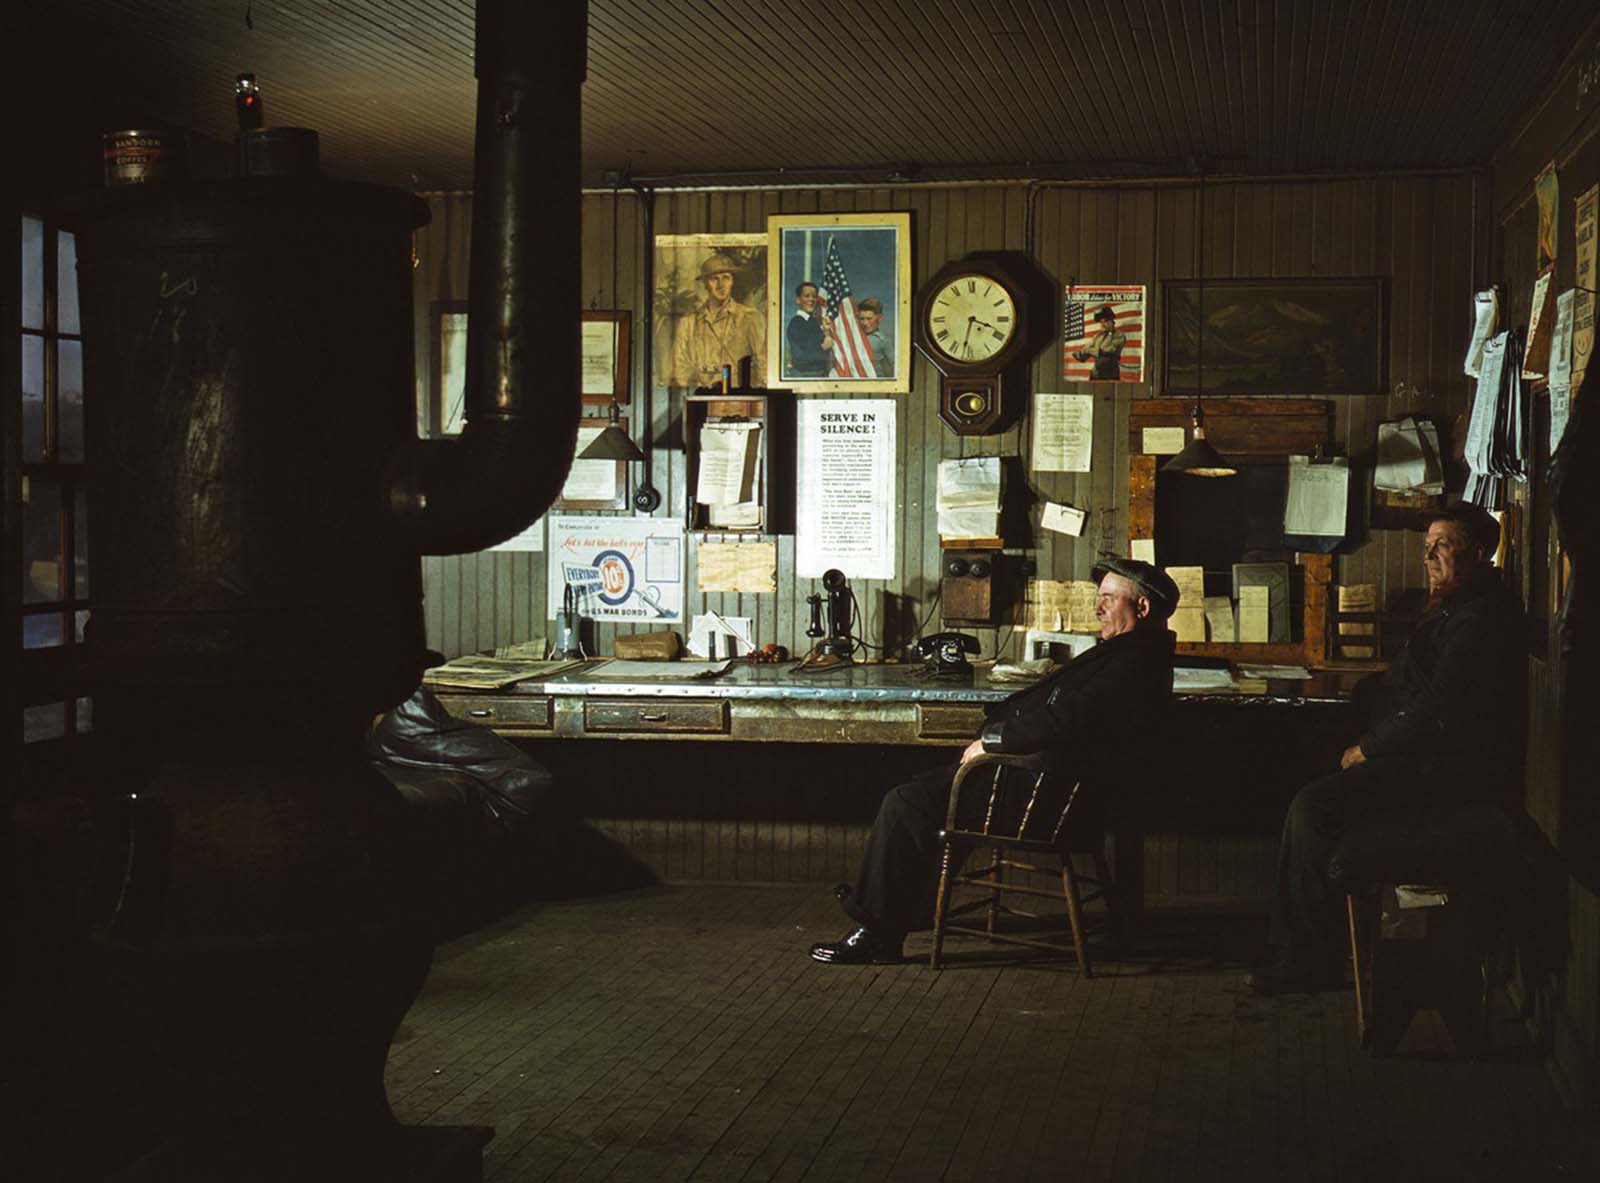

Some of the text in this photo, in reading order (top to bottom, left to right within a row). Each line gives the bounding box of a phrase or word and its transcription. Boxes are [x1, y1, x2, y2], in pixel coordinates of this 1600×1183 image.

[1112, 293, 1140, 301] VICTORY
[820, 413, 876, 423] SERVE IN
[820, 425, 876, 434] SILENCE!
[566, 567, 600, 581] EVERYBODY
[603, 608, 619, 616] WAR
[621, 609, 648, 617] BONDS
